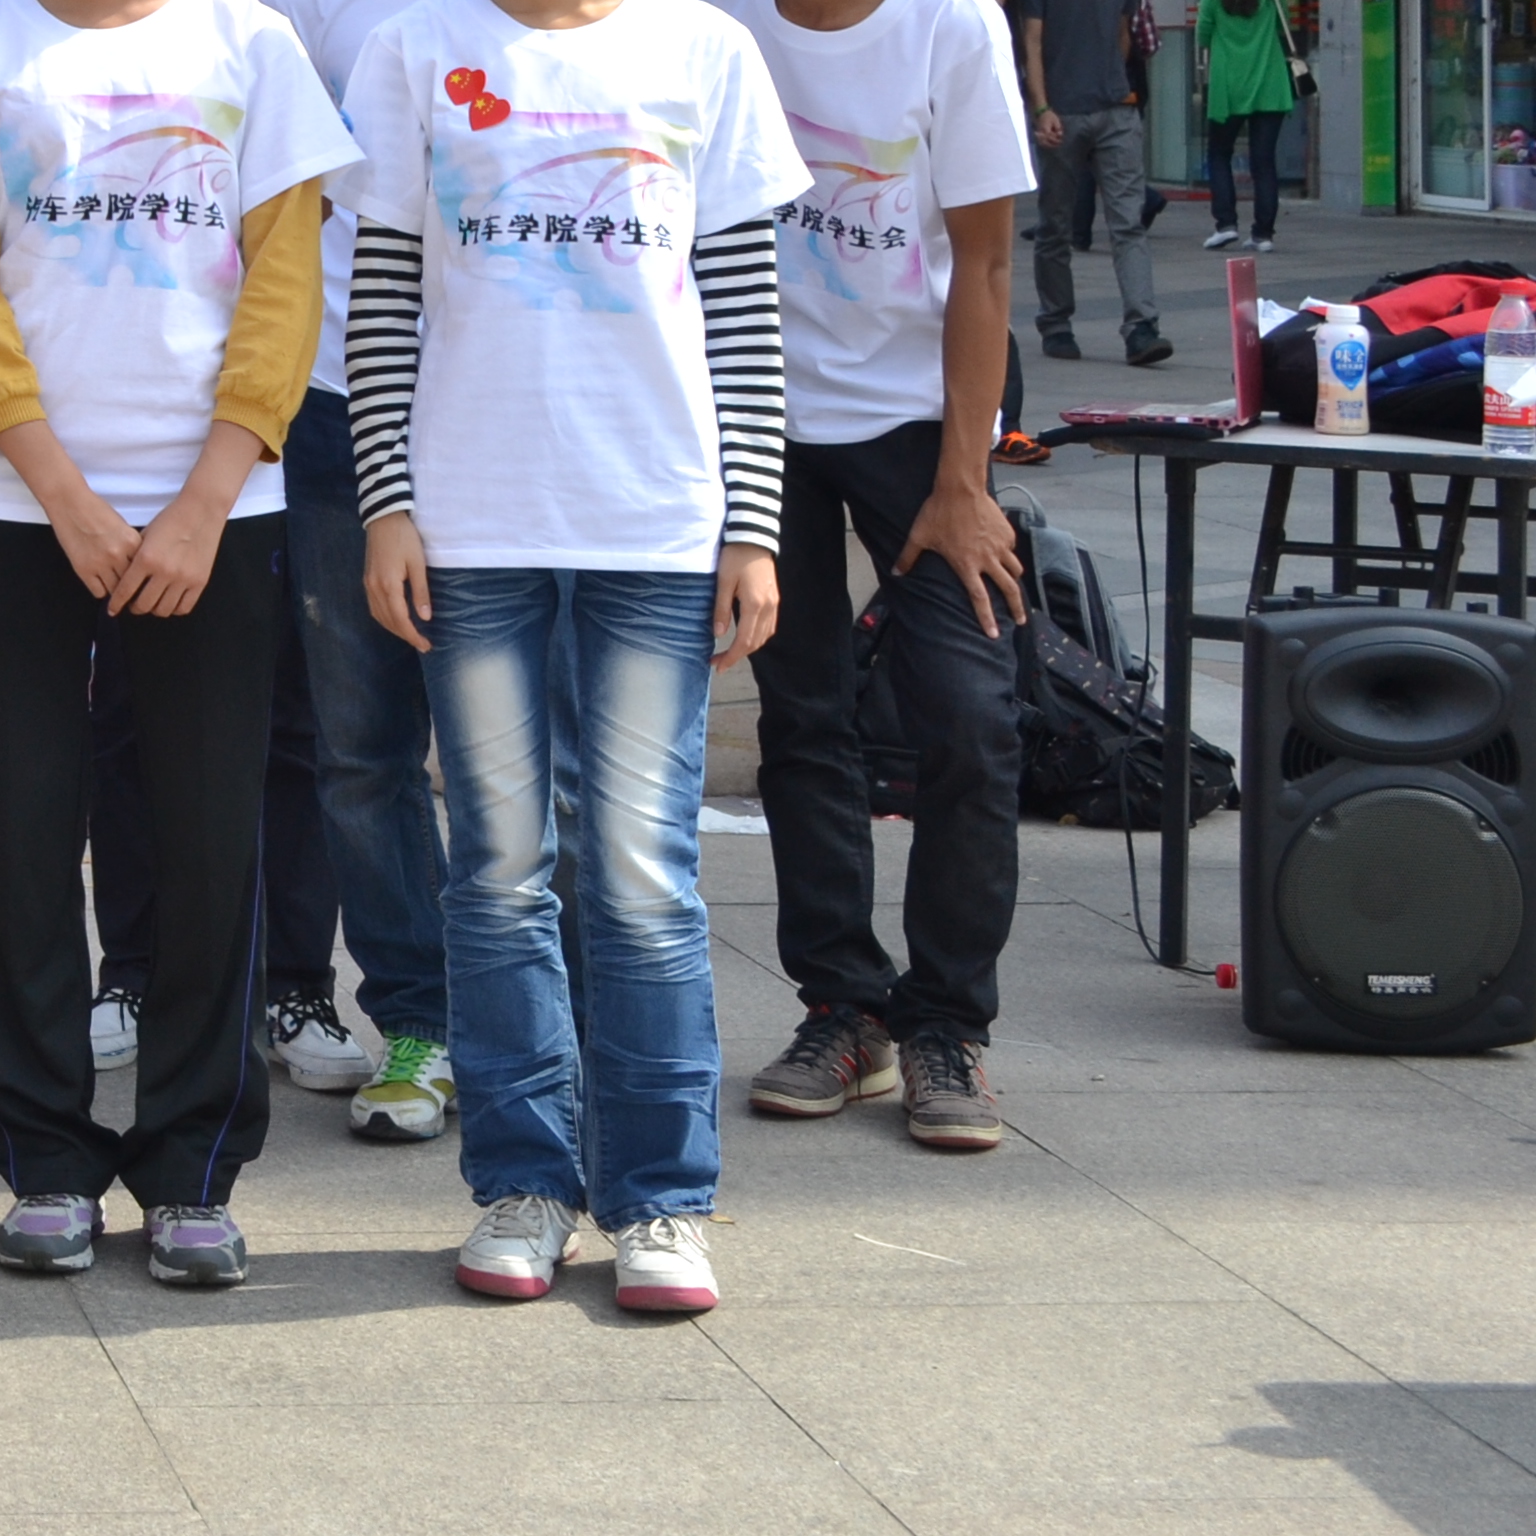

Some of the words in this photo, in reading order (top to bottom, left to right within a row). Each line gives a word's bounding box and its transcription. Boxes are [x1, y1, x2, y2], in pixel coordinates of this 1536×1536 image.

[26, 192, 226, 230] 汽车学院学生会
[458, 213, 673, 252] 汽车学院学生会
